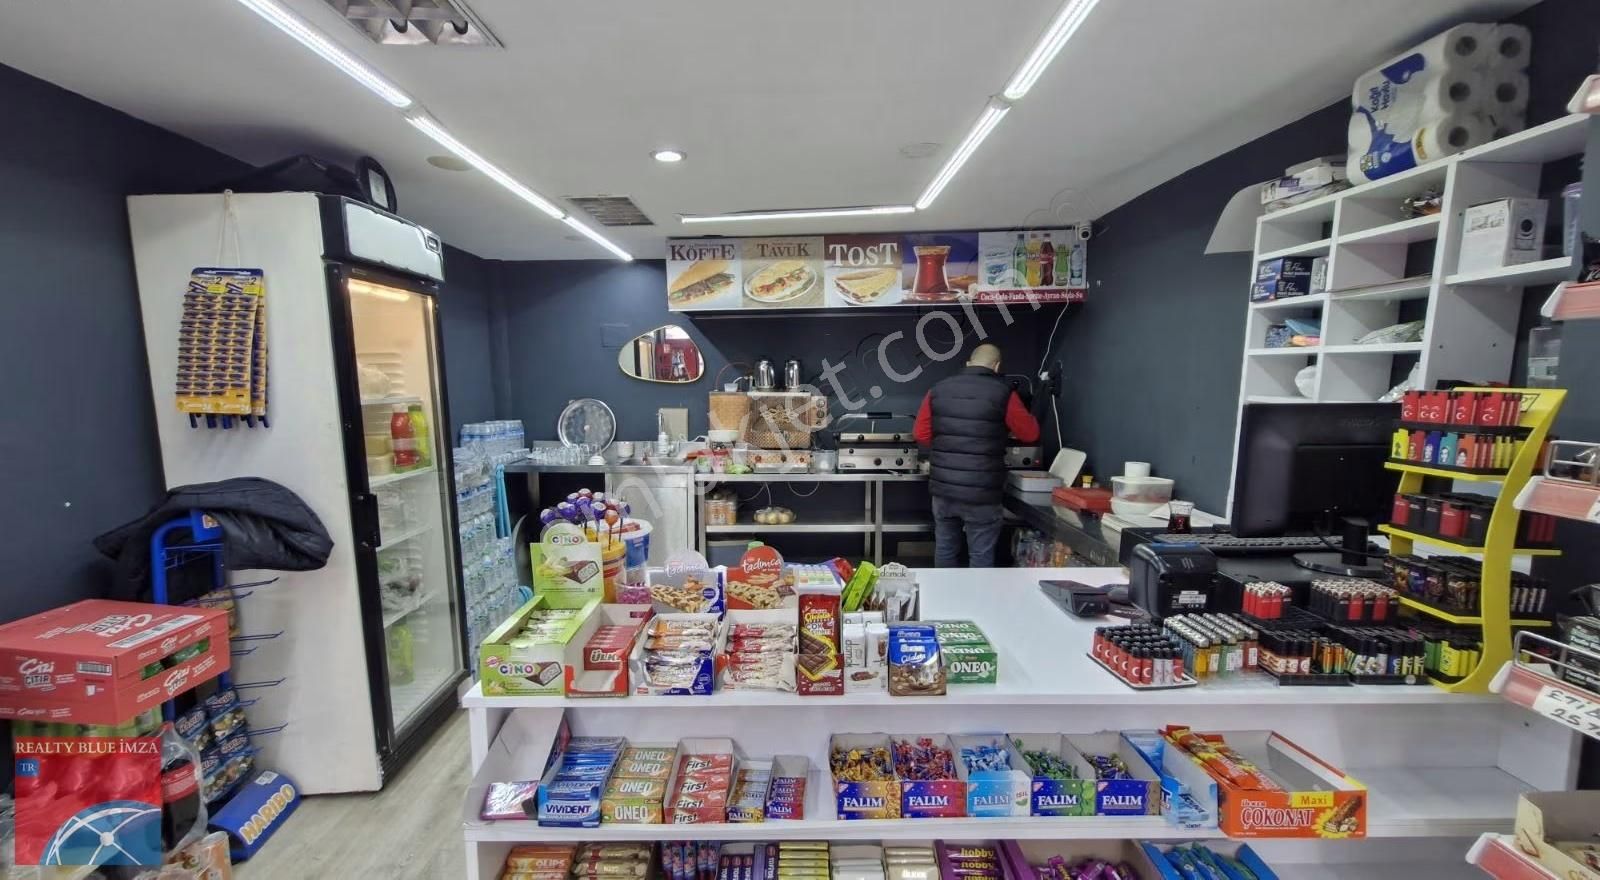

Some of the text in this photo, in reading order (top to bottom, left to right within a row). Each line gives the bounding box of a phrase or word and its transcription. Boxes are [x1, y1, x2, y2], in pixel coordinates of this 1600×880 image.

[670, 243, 735, 260] KÖFTE
[757, 242, 809, 257] TAVUK
[829, 242, 898, 267] TOST
[951, 661, 990, 673] ONEO
[686, 760, 711, 768] First
[681, 781, 706, 790] First
[844, 797, 883, 807] FALIM
[908, 796, 948, 806] FALIM
[973, 796, 1009, 806] FALIM
[1038, 795, 1077, 806] FALIM
[1102, 795, 1142, 806] FALIM
[1301, 795, 1327, 806] Maxi
[239, 783, 295, 845] HARIBO
[614, 805, 649, 820] ONEO
[673, 814, 697, 823] First
[1240, 807, 1314, 830] ÇOKONAT
